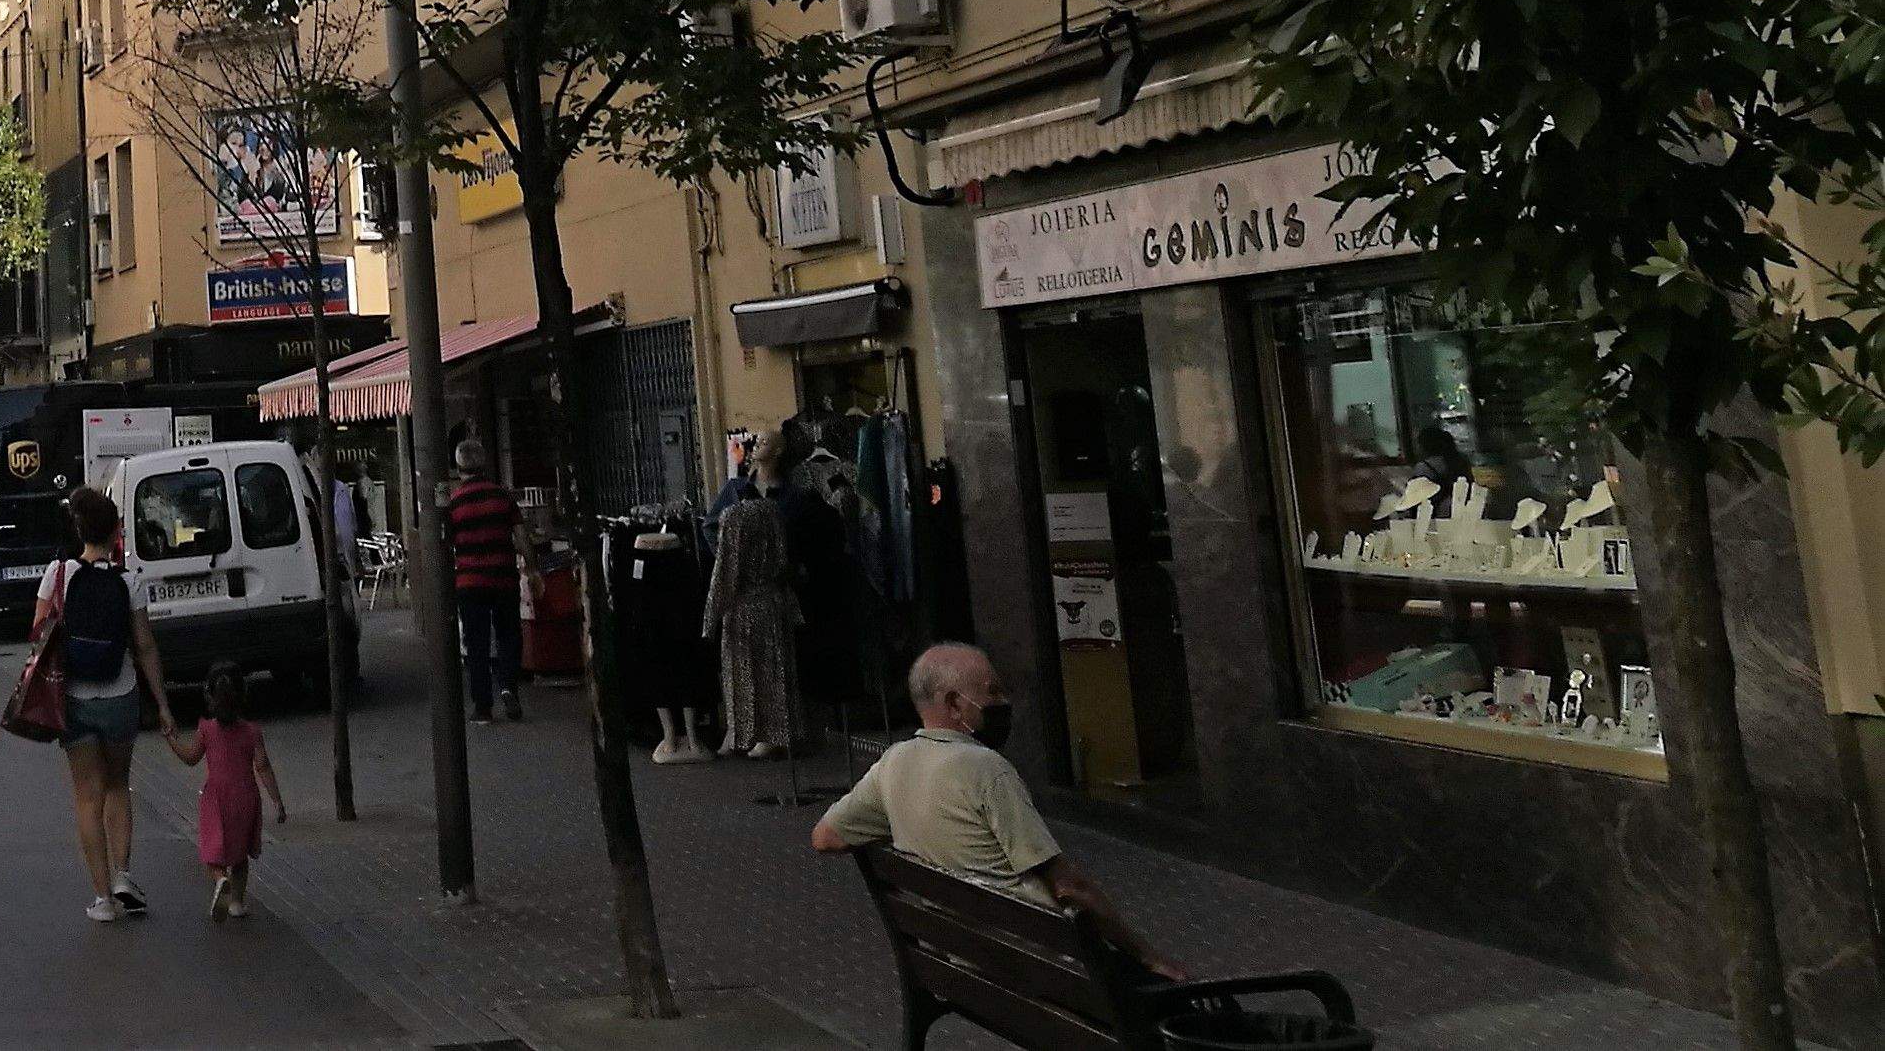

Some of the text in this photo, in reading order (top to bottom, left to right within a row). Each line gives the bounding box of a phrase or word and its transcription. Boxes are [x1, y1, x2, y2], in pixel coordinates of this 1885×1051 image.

[1031, 199, 1116, 235] JOIERIA
[214, 275, 345, 302] British Hose
[1036, 264, 1123, 293] RELLOTGERIA
[232, 303, 327, 319] LANGUAGE SCHOL
[277, 337, 352, 359] panus
[11, 450, 39, 474] ups
[159, 584, 192, 600] 9837
